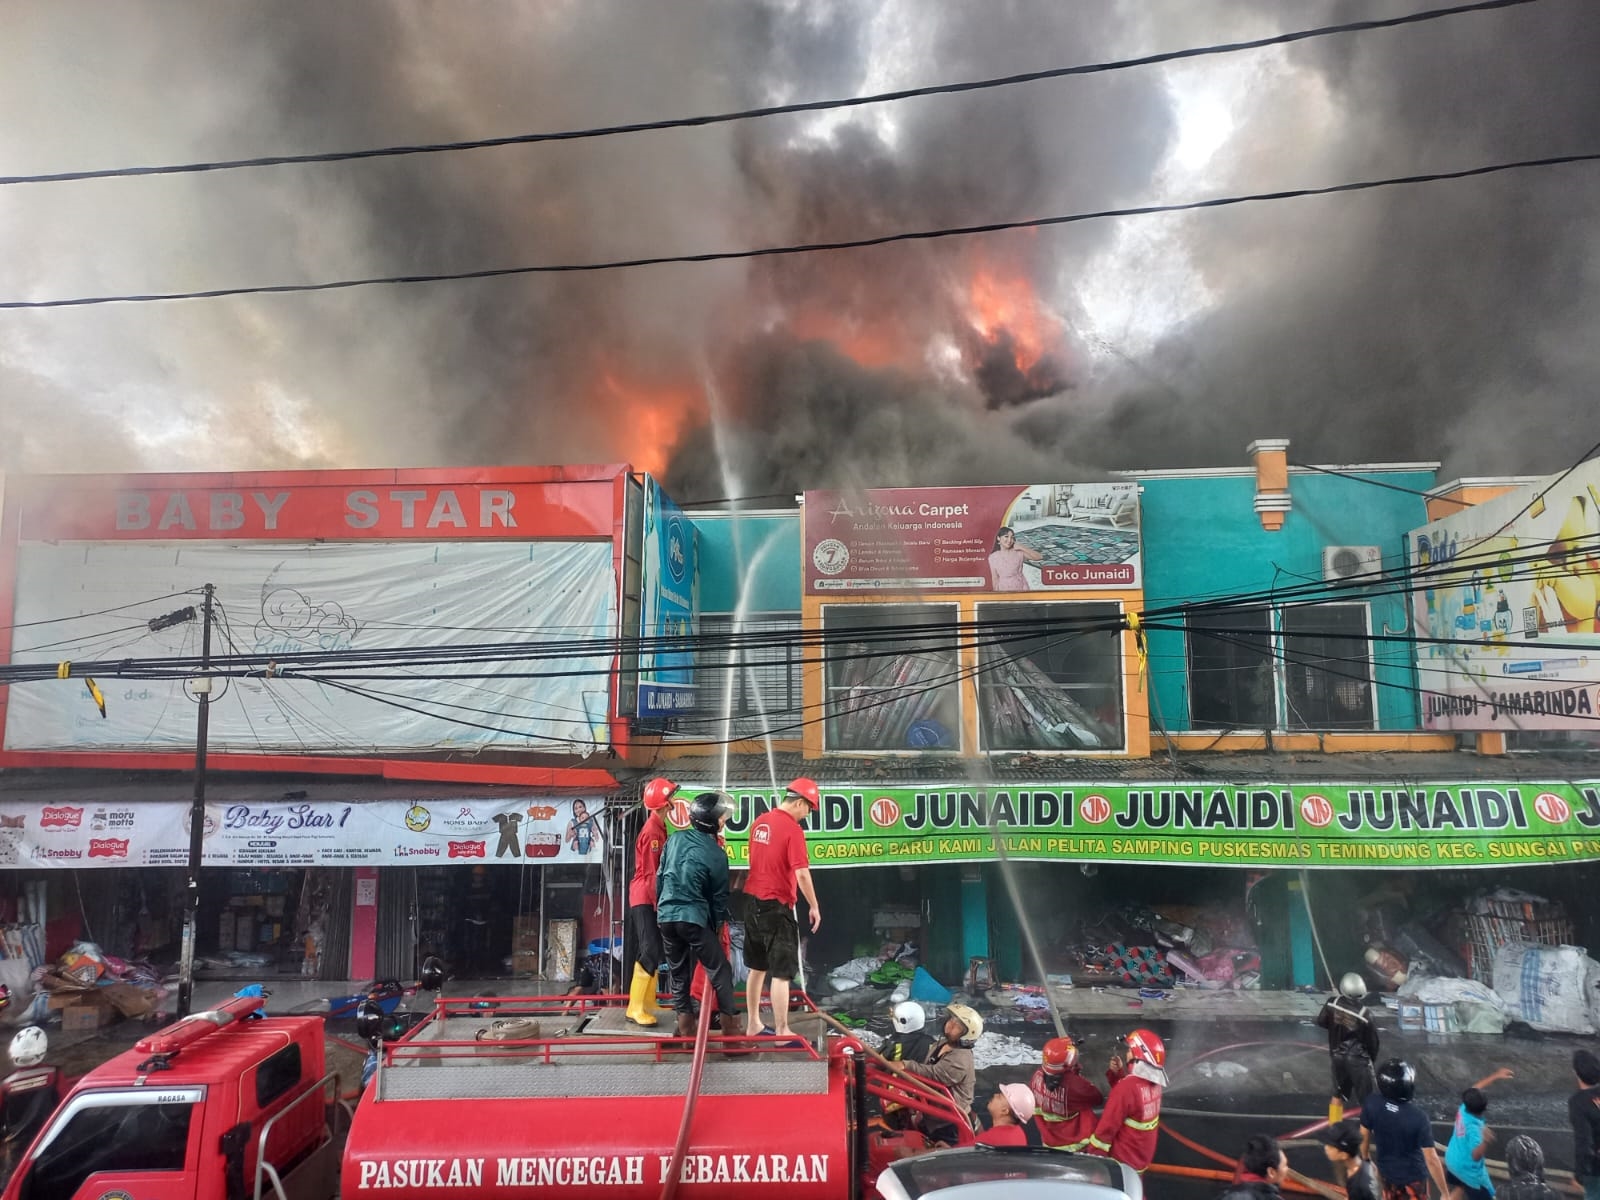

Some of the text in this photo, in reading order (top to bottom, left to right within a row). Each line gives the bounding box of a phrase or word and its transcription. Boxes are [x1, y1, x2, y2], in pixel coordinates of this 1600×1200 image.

[115, 489, 518, 531] BABY STAR
[918, 503, 969, 518] Carpet
[887, 522, 923, 531] Keluarga
[924, 521, 963, 529] Indonesia
[826, 550, 836, 564] 7
[1046, 568, 1130, 580] Toko Junaidi
[1427, 693, 1479, 723] JUNAIDI
[1490, 688, 1592, 721] SAMARINDA
[44, 811, 80, 821] Dialogue
[903, 790, 1075, 829] JUNAIDI
[1114, 790, 1296, 829] JUNAIDI
[1337, 788, 1528, 832] JUNAIDI
[223, 804, 352, 834] Baby Star 1
[92, 841, 125, 850] Dialogue
[409, 847, 440, 856] Snobby
[813, 841, 883, 859] CABANG
[888, 840, 934, 856] BARU
[938, 838, 982, 853] KAMI
[986, 837, 1042, 853] JALAN
[1047, 838, 1106, 853] PELITA
[1111, 839, 1193, 856] SAMPING
[1199, 841, 1312, 858] PUSKESMAS
[1317, 843, 1432, 860] TEMINDUNG
[1436, 842, 1483, 859] KEC.
[1489, 840, 1567, 858] SUNGAI
[47, 849, 82, 858] Snobby
[358, 1158, 485, 1189] PASUKAN
[495, 1156, 644, 1186] MENCEGAH
